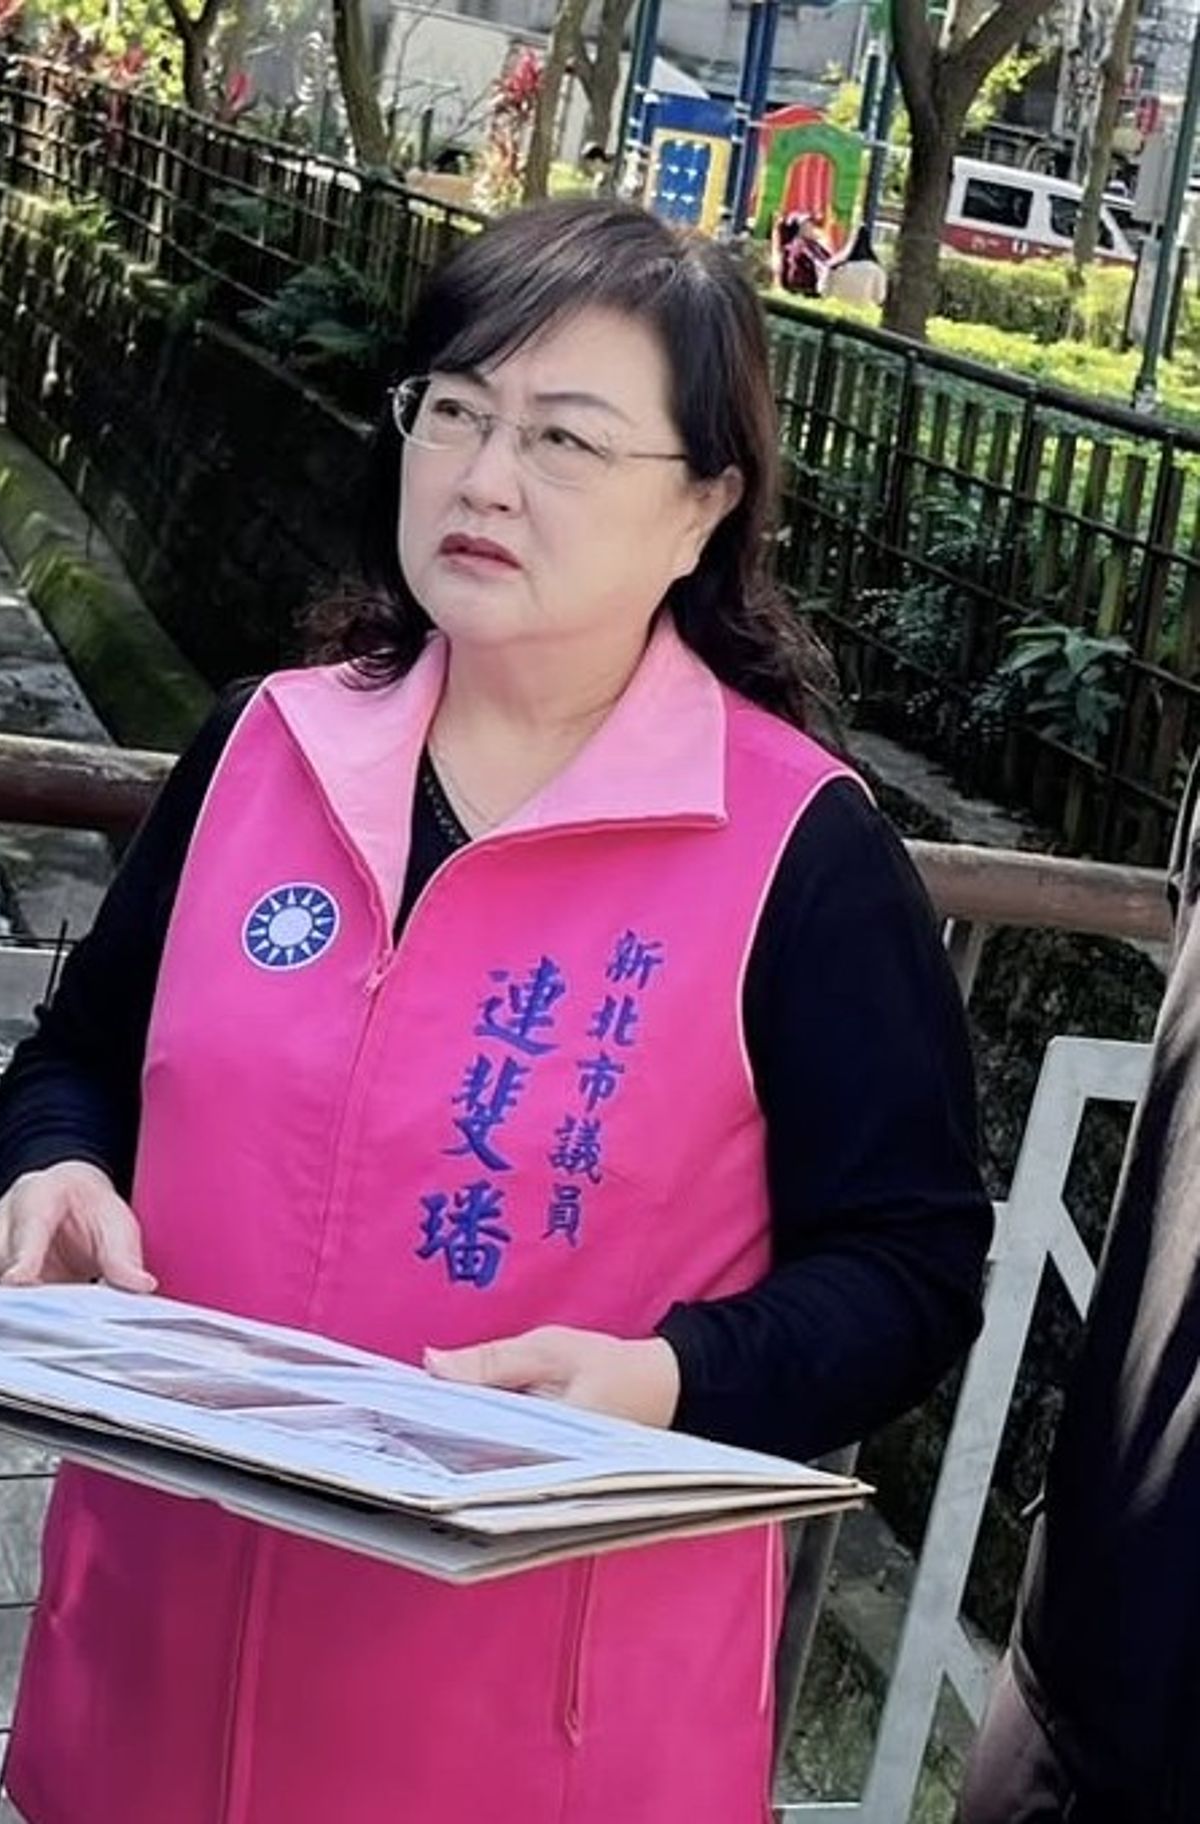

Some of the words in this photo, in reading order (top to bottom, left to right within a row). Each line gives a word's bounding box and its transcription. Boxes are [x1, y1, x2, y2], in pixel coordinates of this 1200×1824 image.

[416, 956, 565, 1288] 連斐璠
[541, 930, 664, 1248] 新北市議員
